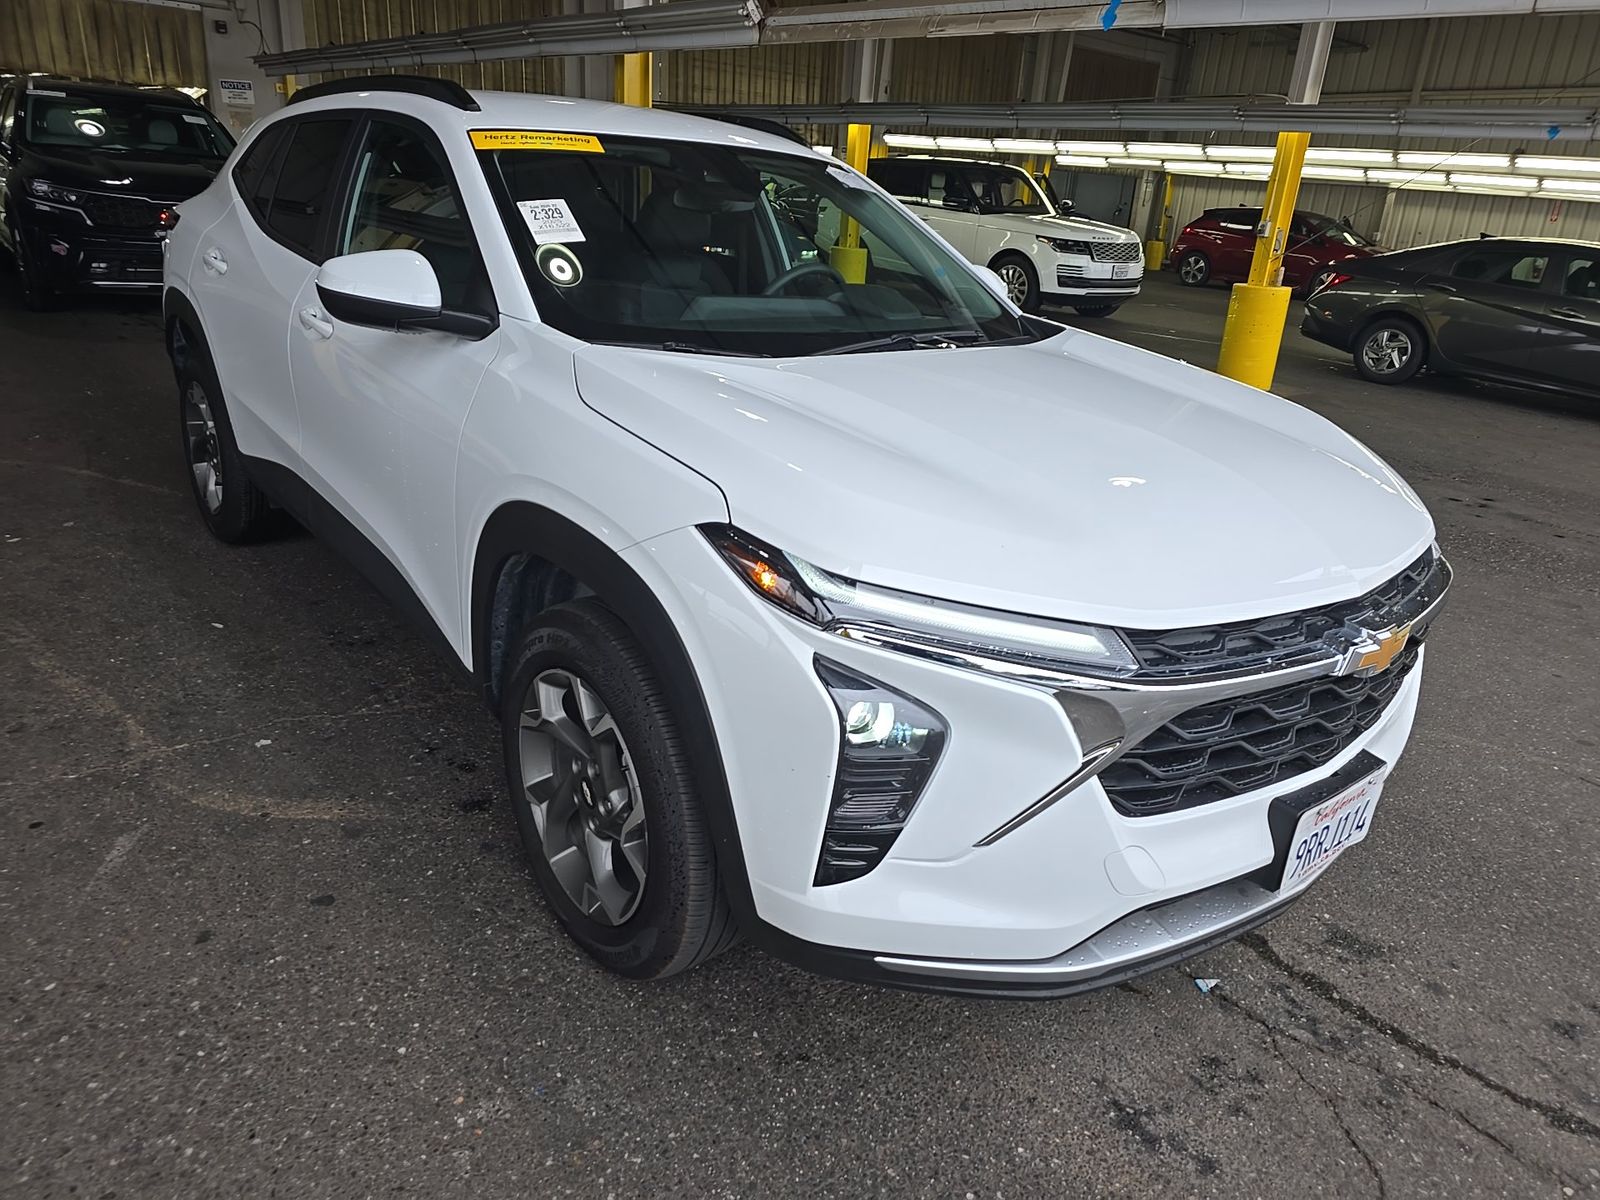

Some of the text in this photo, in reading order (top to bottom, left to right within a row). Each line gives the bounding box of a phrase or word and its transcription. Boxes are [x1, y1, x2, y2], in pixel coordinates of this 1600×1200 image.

[221, 81, 250, 90] NOTICE
[520, 134, 590, 143] Remarketing
[530, 207, 564, 221] 2:329
[1313, 788, 1367, 826] California
[1289, 798, 1371, 880] 9RRJ114
